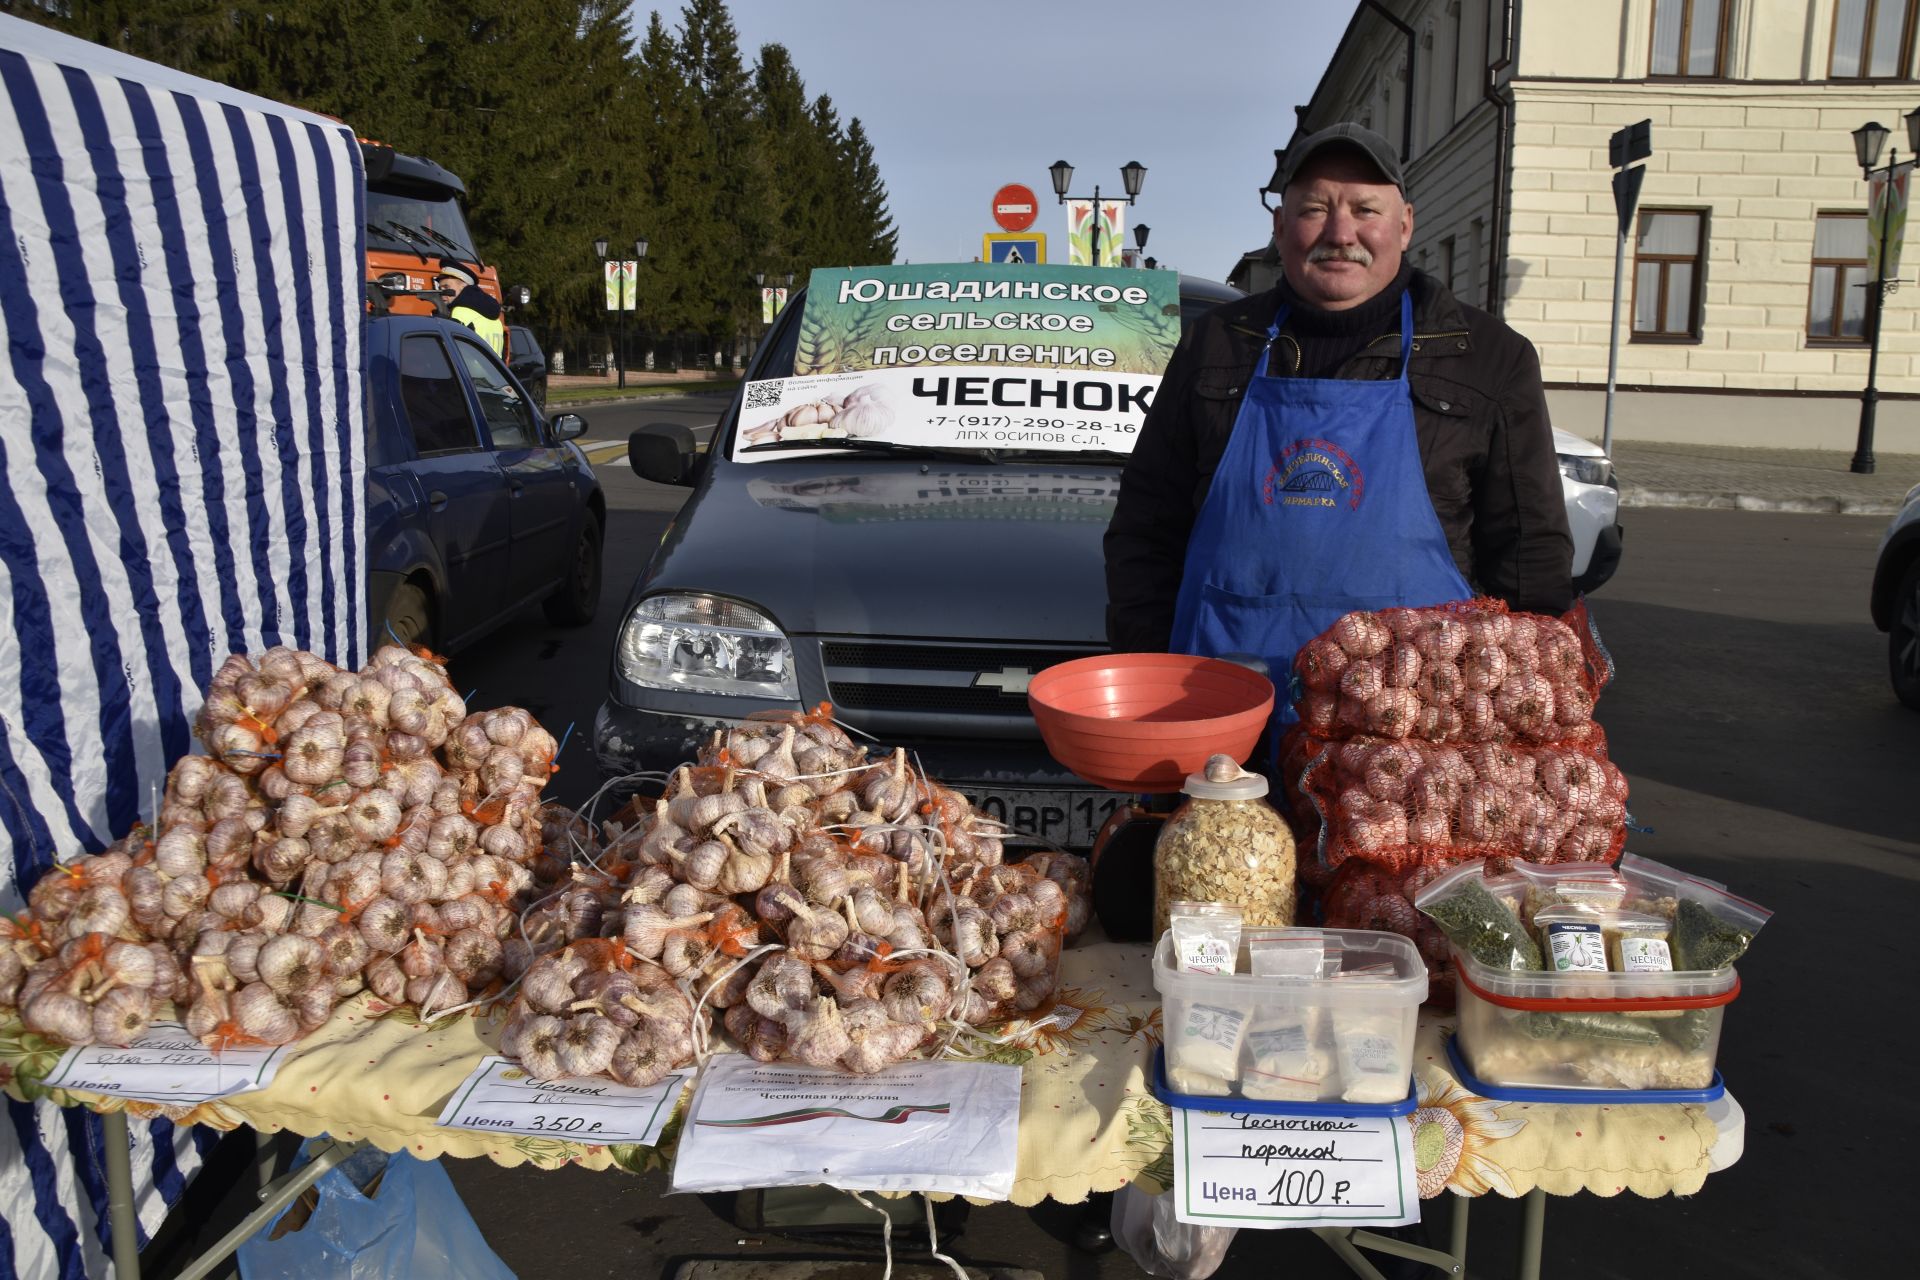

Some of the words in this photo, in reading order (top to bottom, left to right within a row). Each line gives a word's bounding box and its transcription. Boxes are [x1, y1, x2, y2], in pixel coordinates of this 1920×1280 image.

[838, 279, 1149, 306] Юшадинское
[886, 311, 1094, 333] сельское
[872, 343, 1117, 367] поселение
[912, 377, 1154, 414] ЧЕСНОК
[926, 415, 1136, 434] +7-(917)-290-28-16
[955, 430, 988, 440] ЛПХ
[994, 431, 1065, 443] ОСИПОВ
[1071, 434, 1106, 445] С.Л.
[1283, 497, 1336, 507] ЯРМАРКА
[1188, 955, 1225, 964] ЧЕСНОК
[1630, 955, 1668, 966] ЧЕСНОК
[70, 1079, 121, 1090] Цена
[760, 1092, 828, 1101] Чесночная
[462, 1115, 514, 1128] Цена
[529, 1115, 585, 1132] 350
[1202, 1182, 1257, 1203] Цена
[1268, 1169, 1325, 1206] 100
